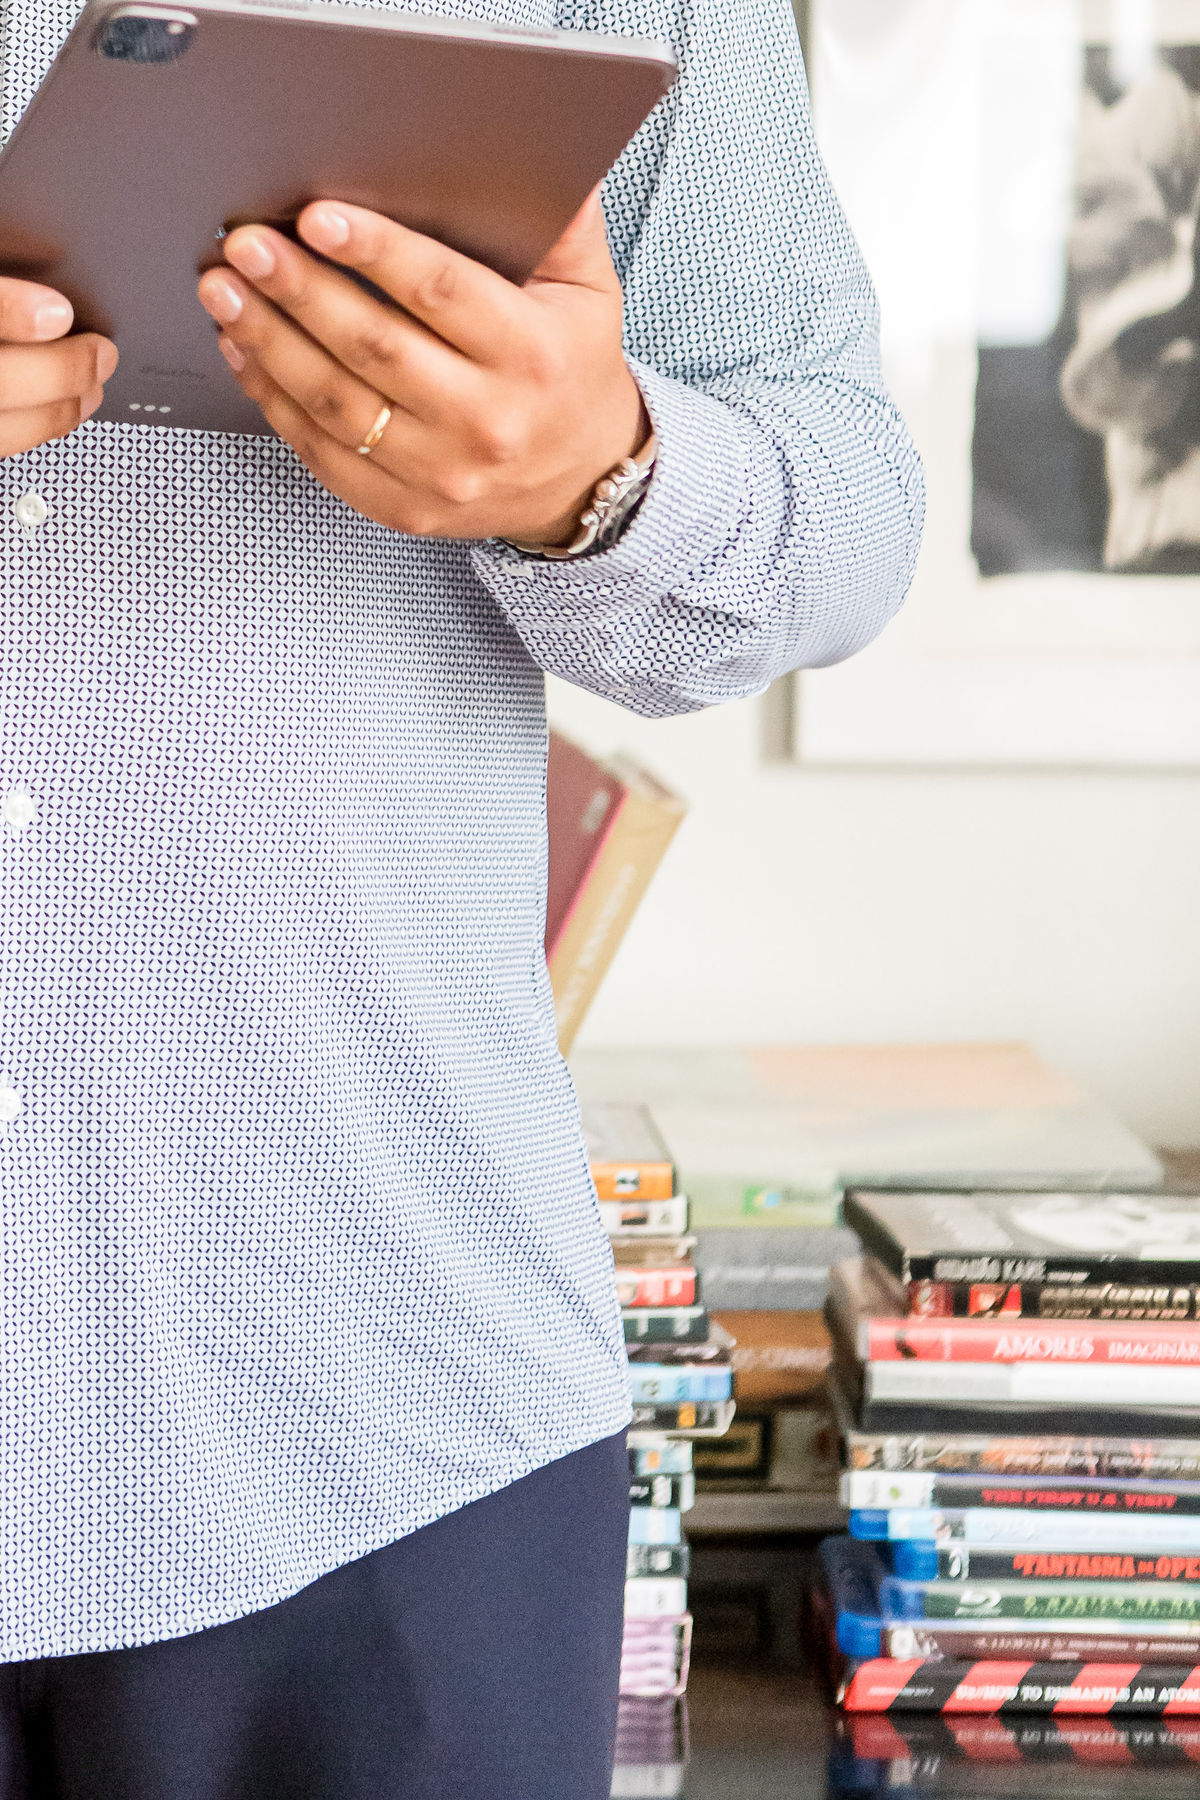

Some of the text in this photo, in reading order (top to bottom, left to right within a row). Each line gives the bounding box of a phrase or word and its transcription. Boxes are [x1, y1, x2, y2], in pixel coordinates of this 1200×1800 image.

[994, 1336, 1095, 1359] AMORES
[1022, 1555, 1136, 1576] FANTASMA
[1020, 1686, 1042, 1701] TO
[1044, 1686, 1131, 1702] DISMANTLE
[1132, 1688, 1156, 1702] AN
